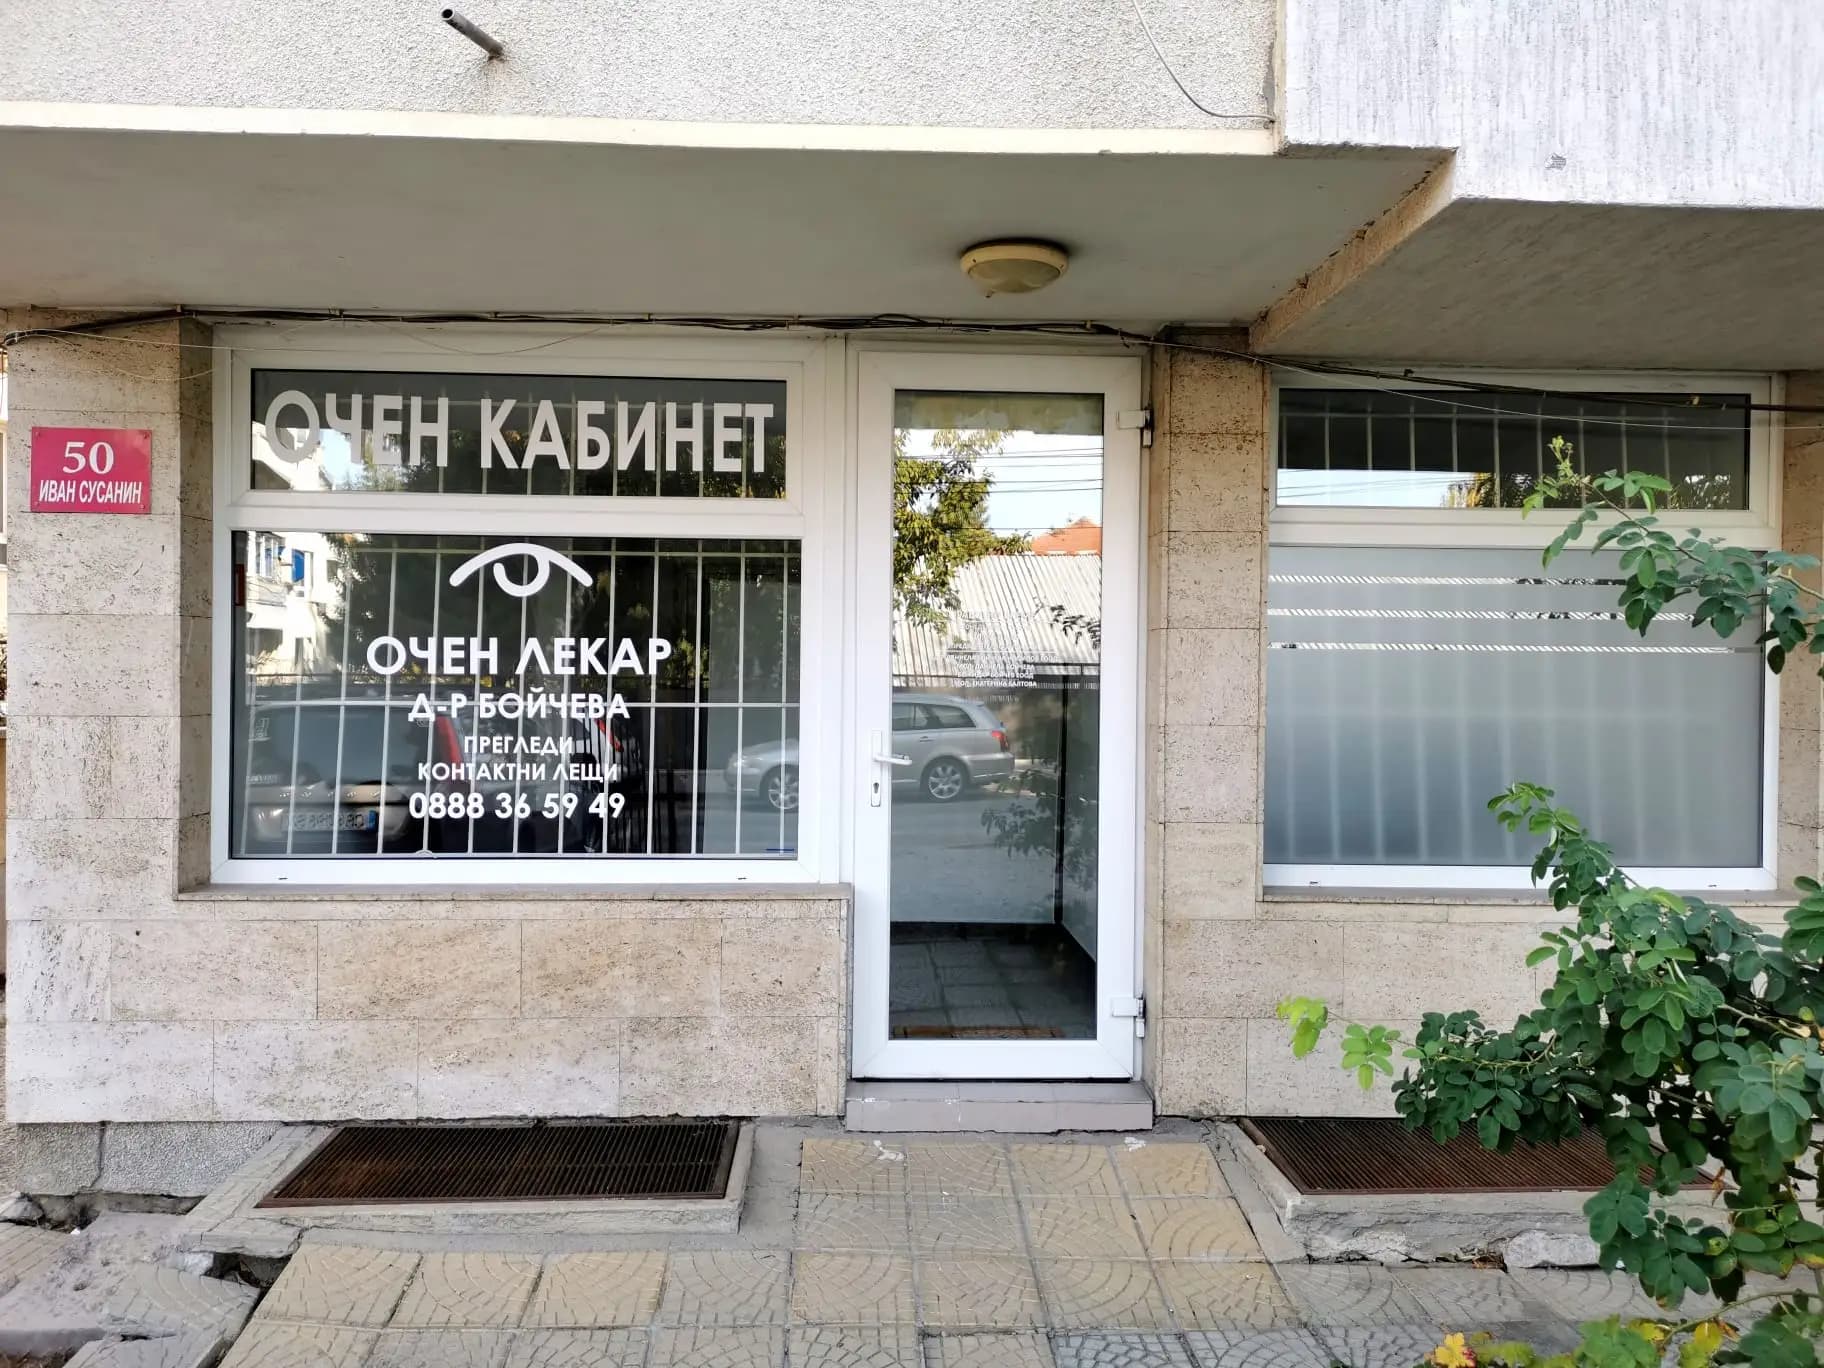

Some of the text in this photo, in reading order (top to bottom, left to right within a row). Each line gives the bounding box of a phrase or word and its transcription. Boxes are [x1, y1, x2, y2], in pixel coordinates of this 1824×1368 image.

[264, 389, 775, 473] ОЧЕН КАБИНЕТ
[62, 441, 115, 475] 50
[39, 480, 142, 504] ИВАН СУСАНИН
[366, 636, 672, 675] ОЧЕН ЛЕКАР
[408, 687, 630, 722] Д-Р БОЙЧЕВА
[464, 736, 573, 756] ПРЕГЛЕДИ
[417, 763, 618, 783] КОНТАКТНИ ЛЕЩИ
[409, 792, 625, 819] 0888 36 59 49
